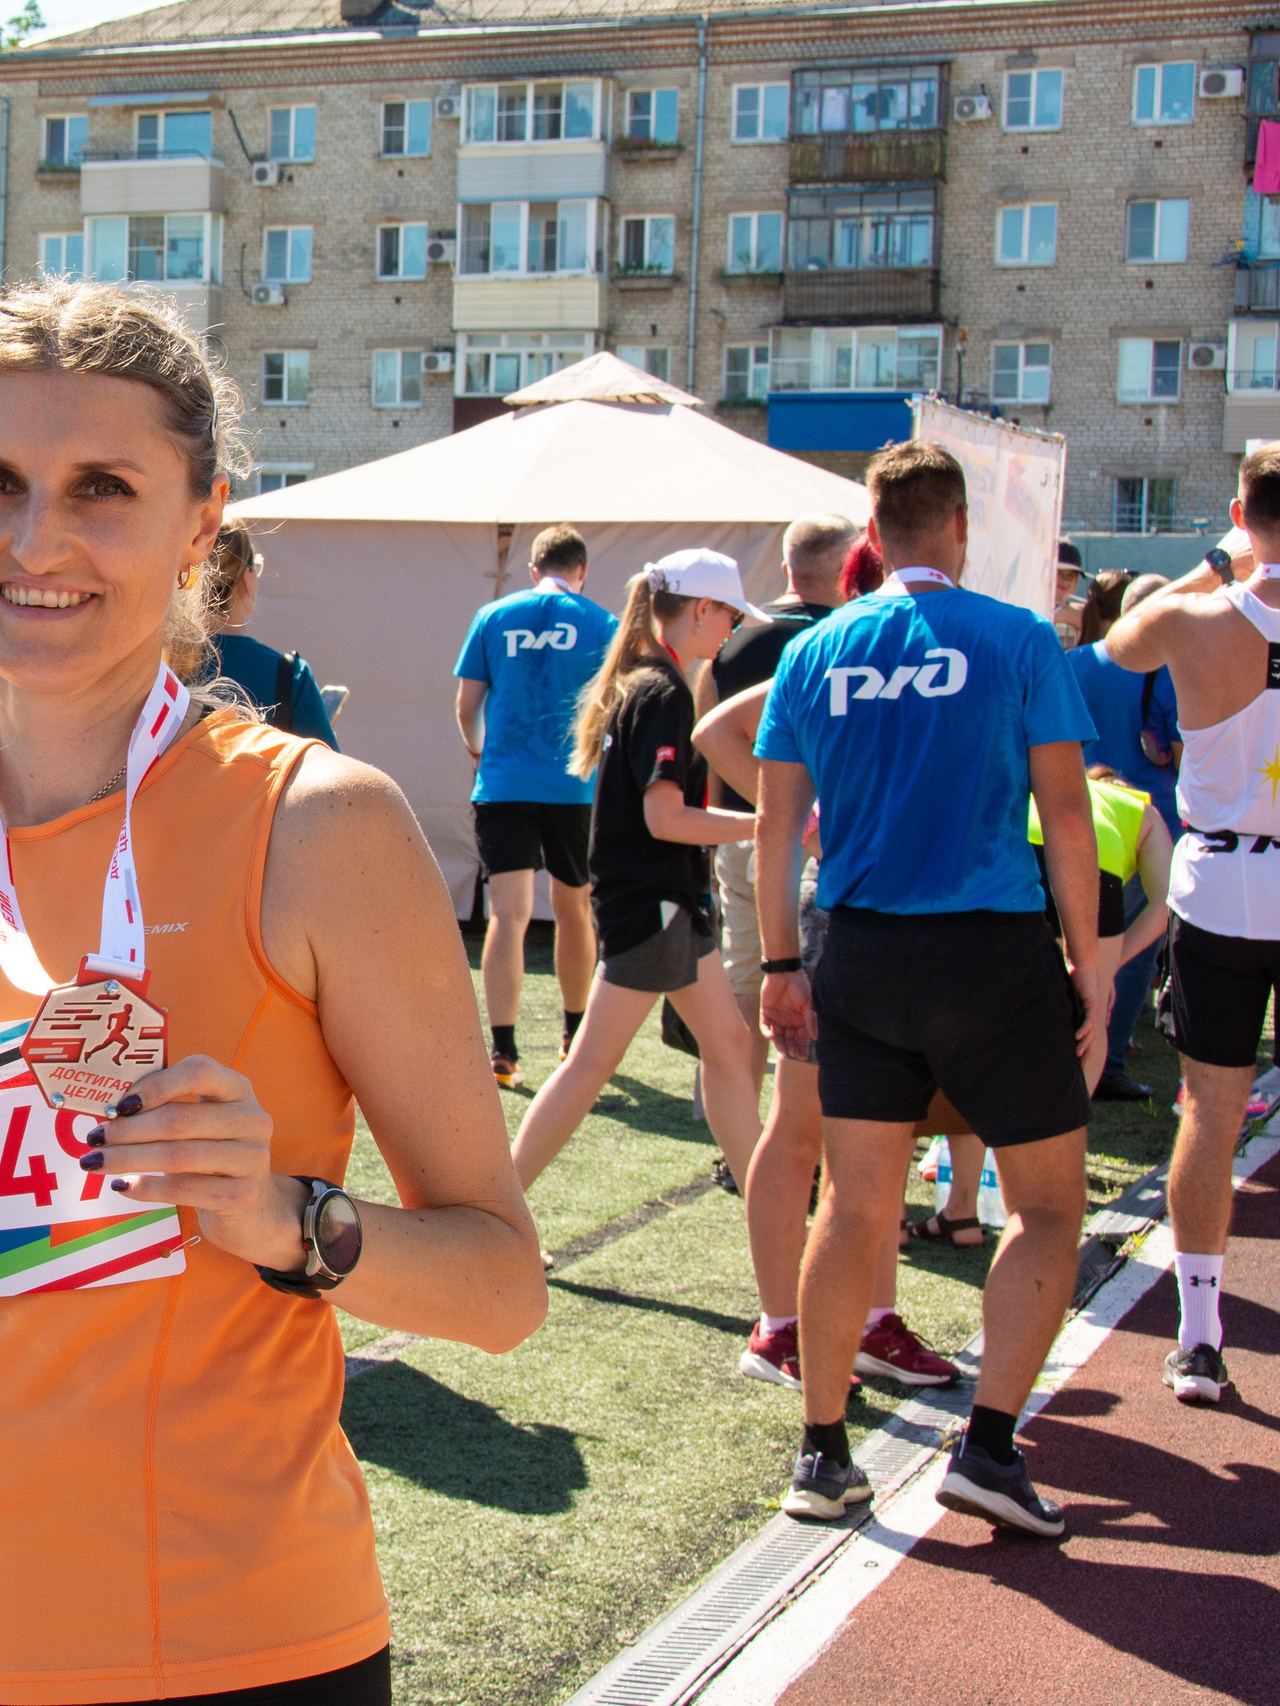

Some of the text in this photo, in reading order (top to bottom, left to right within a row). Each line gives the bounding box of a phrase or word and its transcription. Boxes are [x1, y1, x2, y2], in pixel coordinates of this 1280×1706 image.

[503, 622, 578, 657] РЖД
[824, 648, 968, 717] РЖД
[143, 921, 190, 935] EMIX
[49, 1065, 133, 1093] ДОСТИГАЯ
[63, 1083, 113, 1105] ЦЕЛИ!
